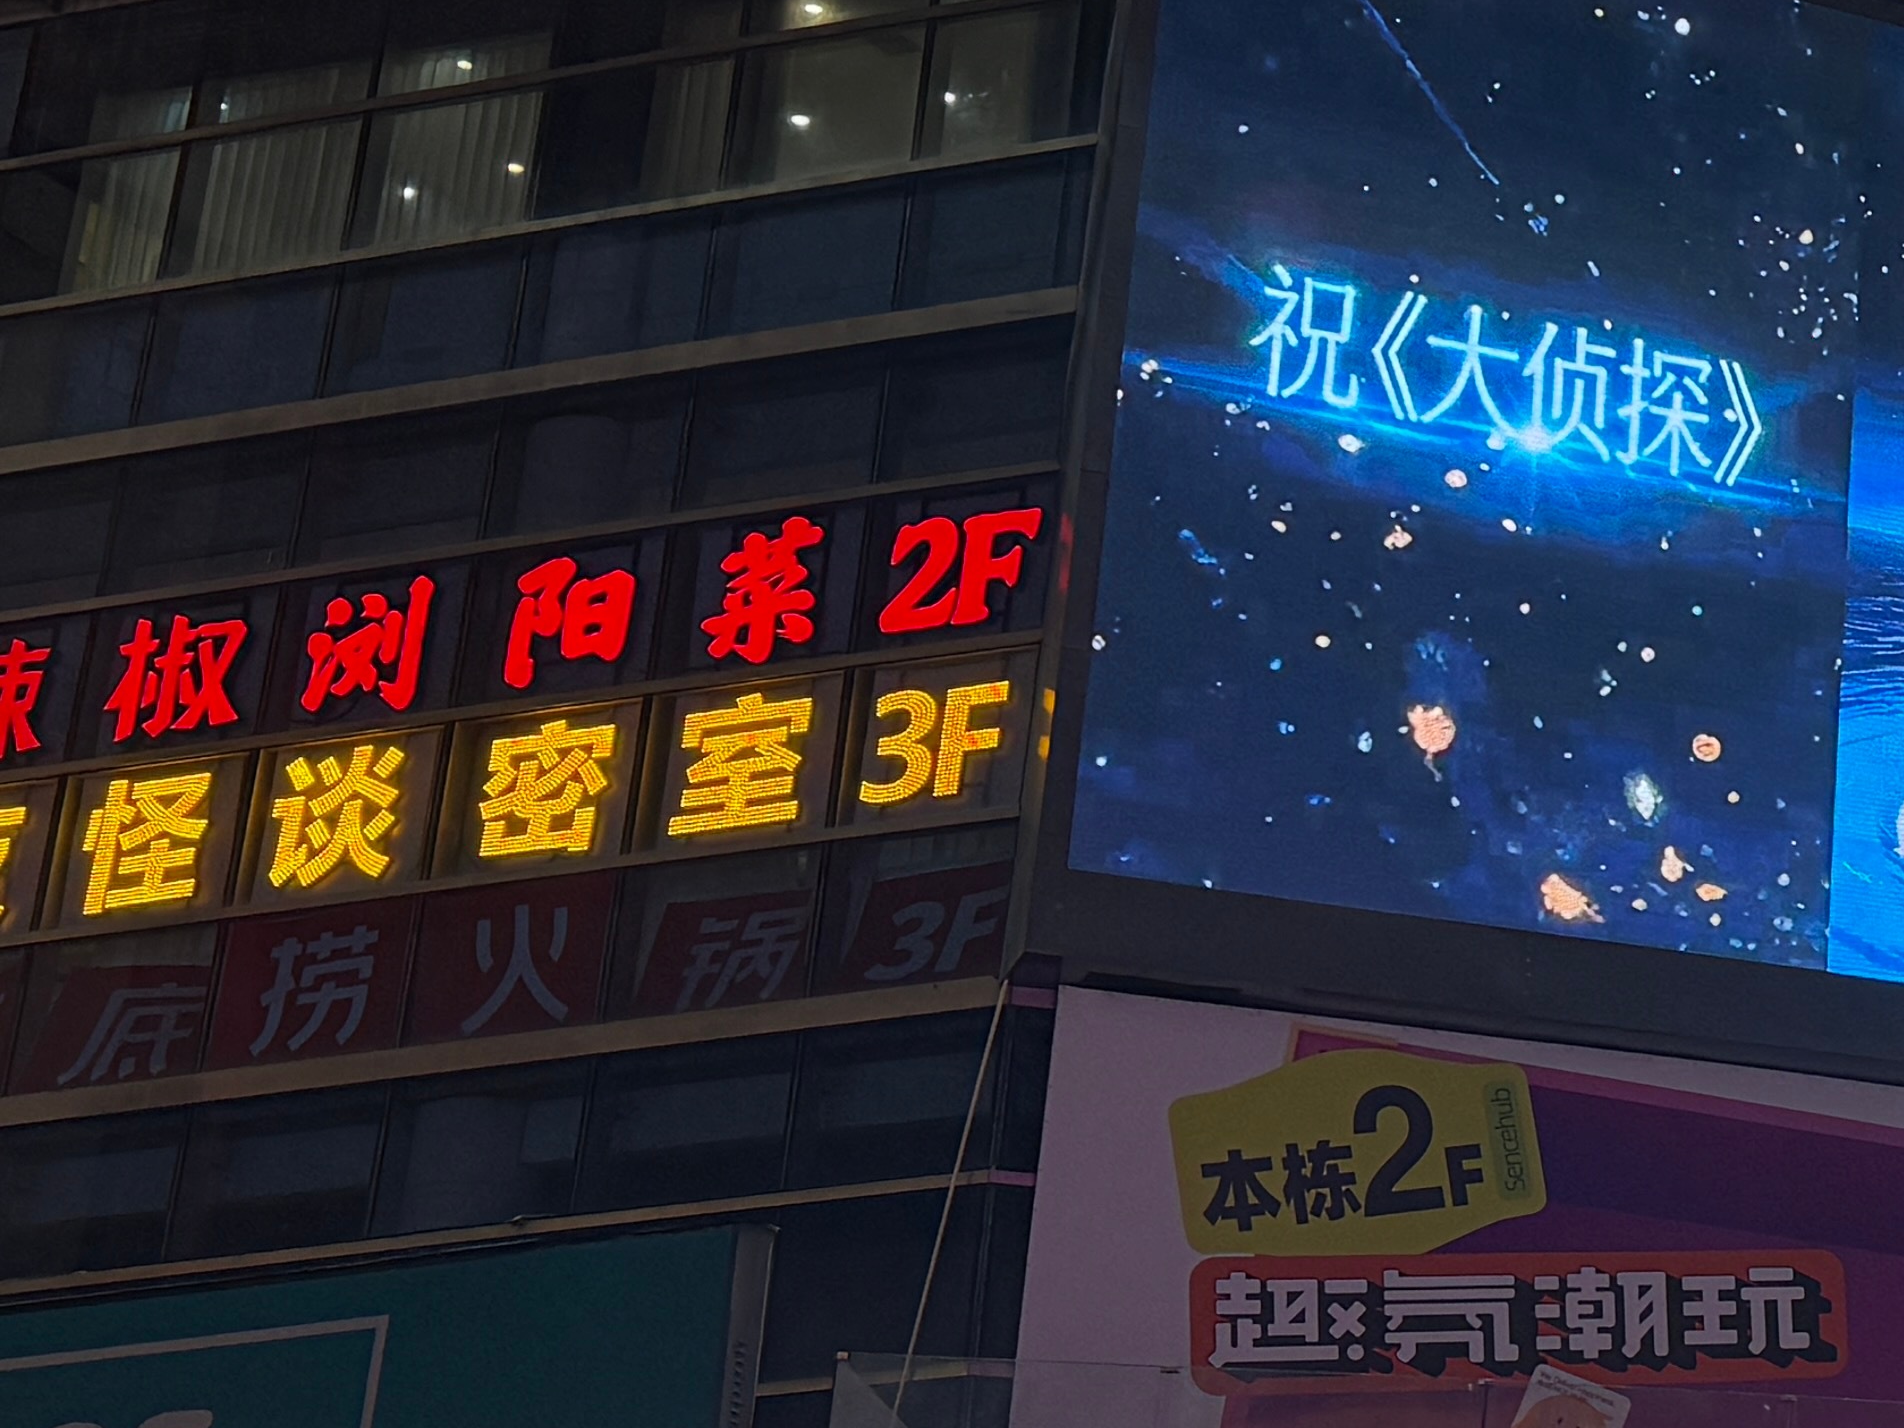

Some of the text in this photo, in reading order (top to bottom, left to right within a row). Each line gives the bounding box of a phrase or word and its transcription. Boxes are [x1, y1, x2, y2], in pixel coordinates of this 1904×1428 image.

[1248, 262, 1763, 487] 祝《大侦探》
[0, 679, 1011, 918] 怪谈密室3F
[1201, 1084, 1486, 1233] 本栋2F
